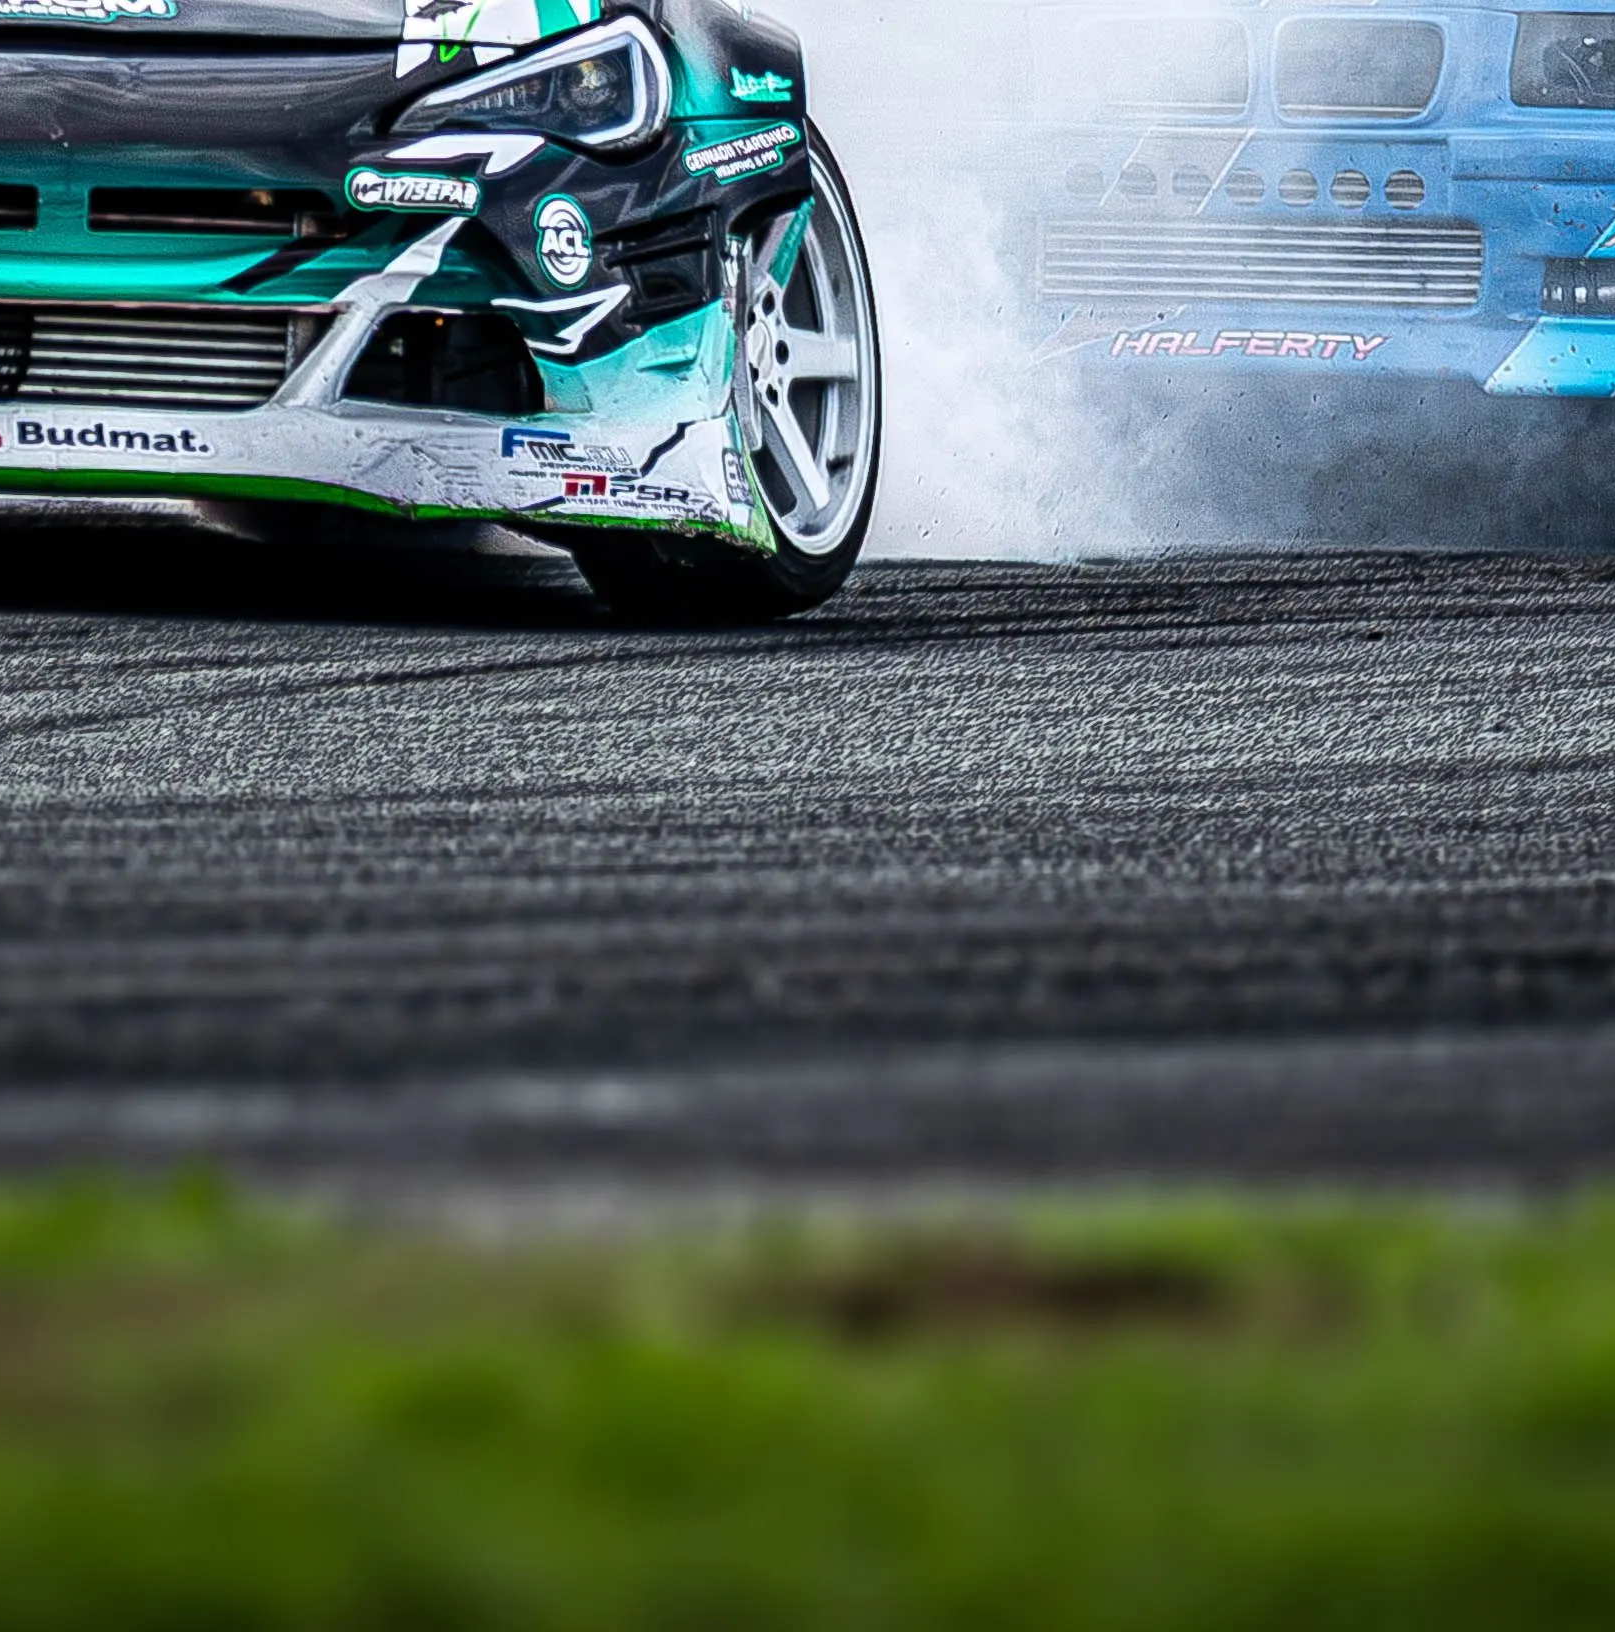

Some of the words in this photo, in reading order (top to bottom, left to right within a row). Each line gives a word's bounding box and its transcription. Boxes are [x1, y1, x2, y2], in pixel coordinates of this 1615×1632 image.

[732, 126, 796, 156] TSARENKO
[541, 228, 590, 256] ACL
[1111, 330, 1390, 360] HALFERTY
[16, 421, 210, 454] Budmat.
[609, 482, 690, 505] PSR
